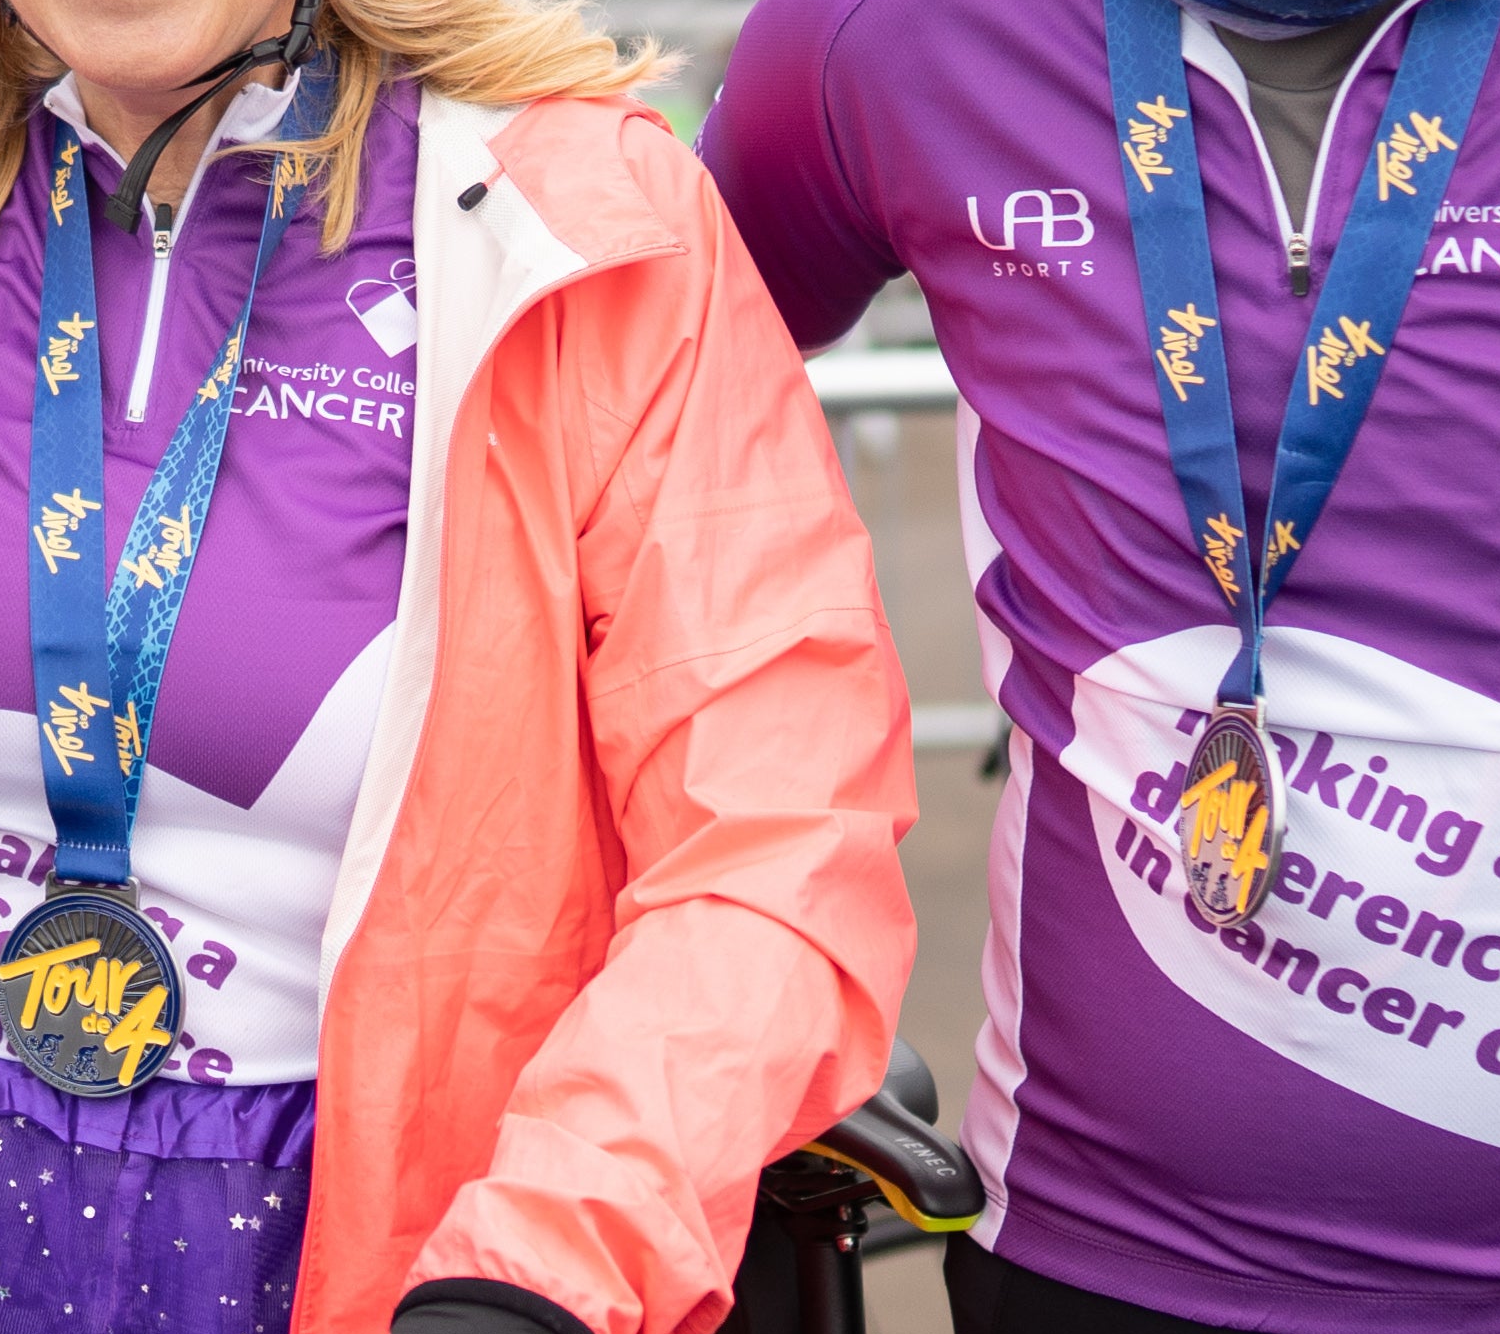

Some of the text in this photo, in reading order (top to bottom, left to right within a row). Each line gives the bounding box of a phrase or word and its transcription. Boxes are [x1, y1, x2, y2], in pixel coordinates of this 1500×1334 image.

[1123, 117, 1173, 193] Tour
[1377, 123, 1420, 201] Tour
[993, 260, 1095, 277] SPORTS
[239, 357, 415, 397] niversity Colle
[1156, 325, 1205, 402] Tour
[1307, 327, 1349, 405] Tour
[33, 506, 80, 574] Tour
[43, 701, 94, 776] Tour
[1182, 760, 1256, 858] Tour
[1231, 805, 1269, 914] 4
[81, 1012, 113, 1034] de
[104, 985, 171, 1086] 4
